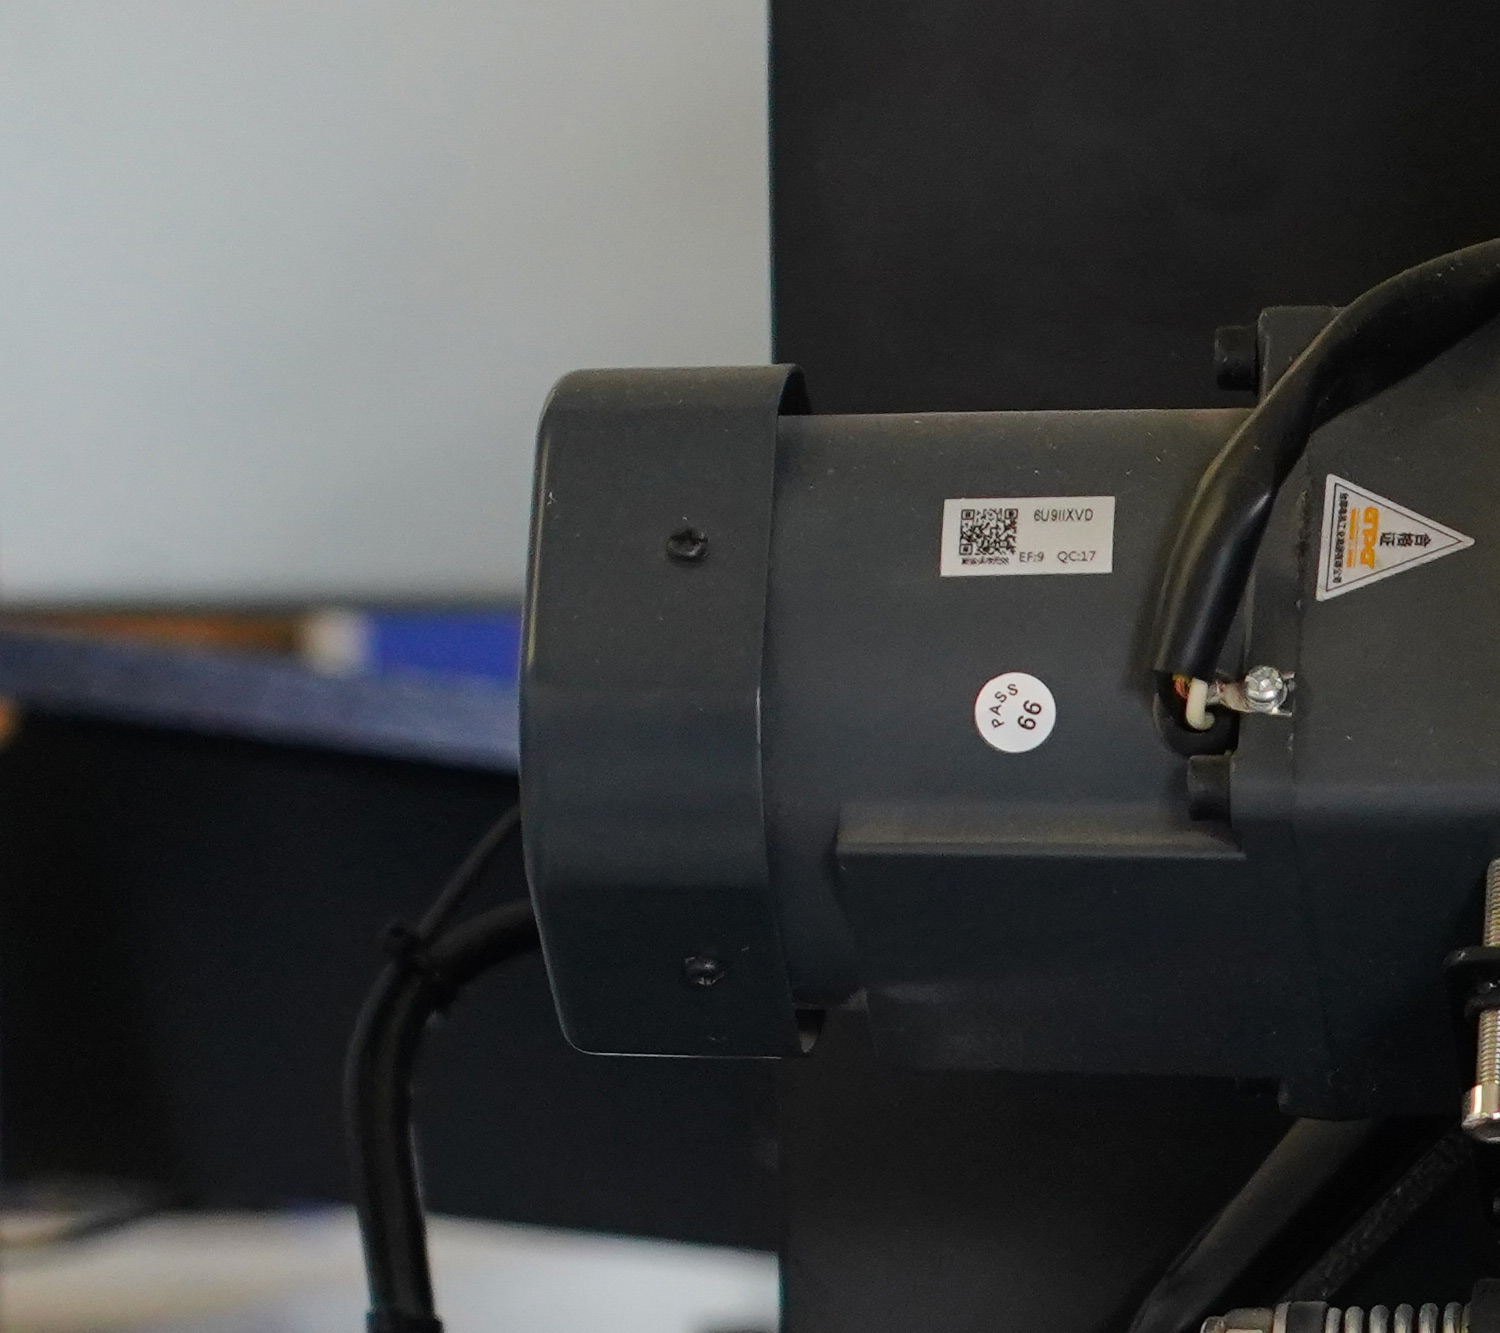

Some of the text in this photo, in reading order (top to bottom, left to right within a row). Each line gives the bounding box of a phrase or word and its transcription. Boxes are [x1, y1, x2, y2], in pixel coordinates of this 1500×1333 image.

[1379, 531, 1432, 548] 合格证
[1018, 551, 1046, 564] EF:9
[1056, 550, 1097, 564] QC:17
[988, 683, 1019, 729] PASS
